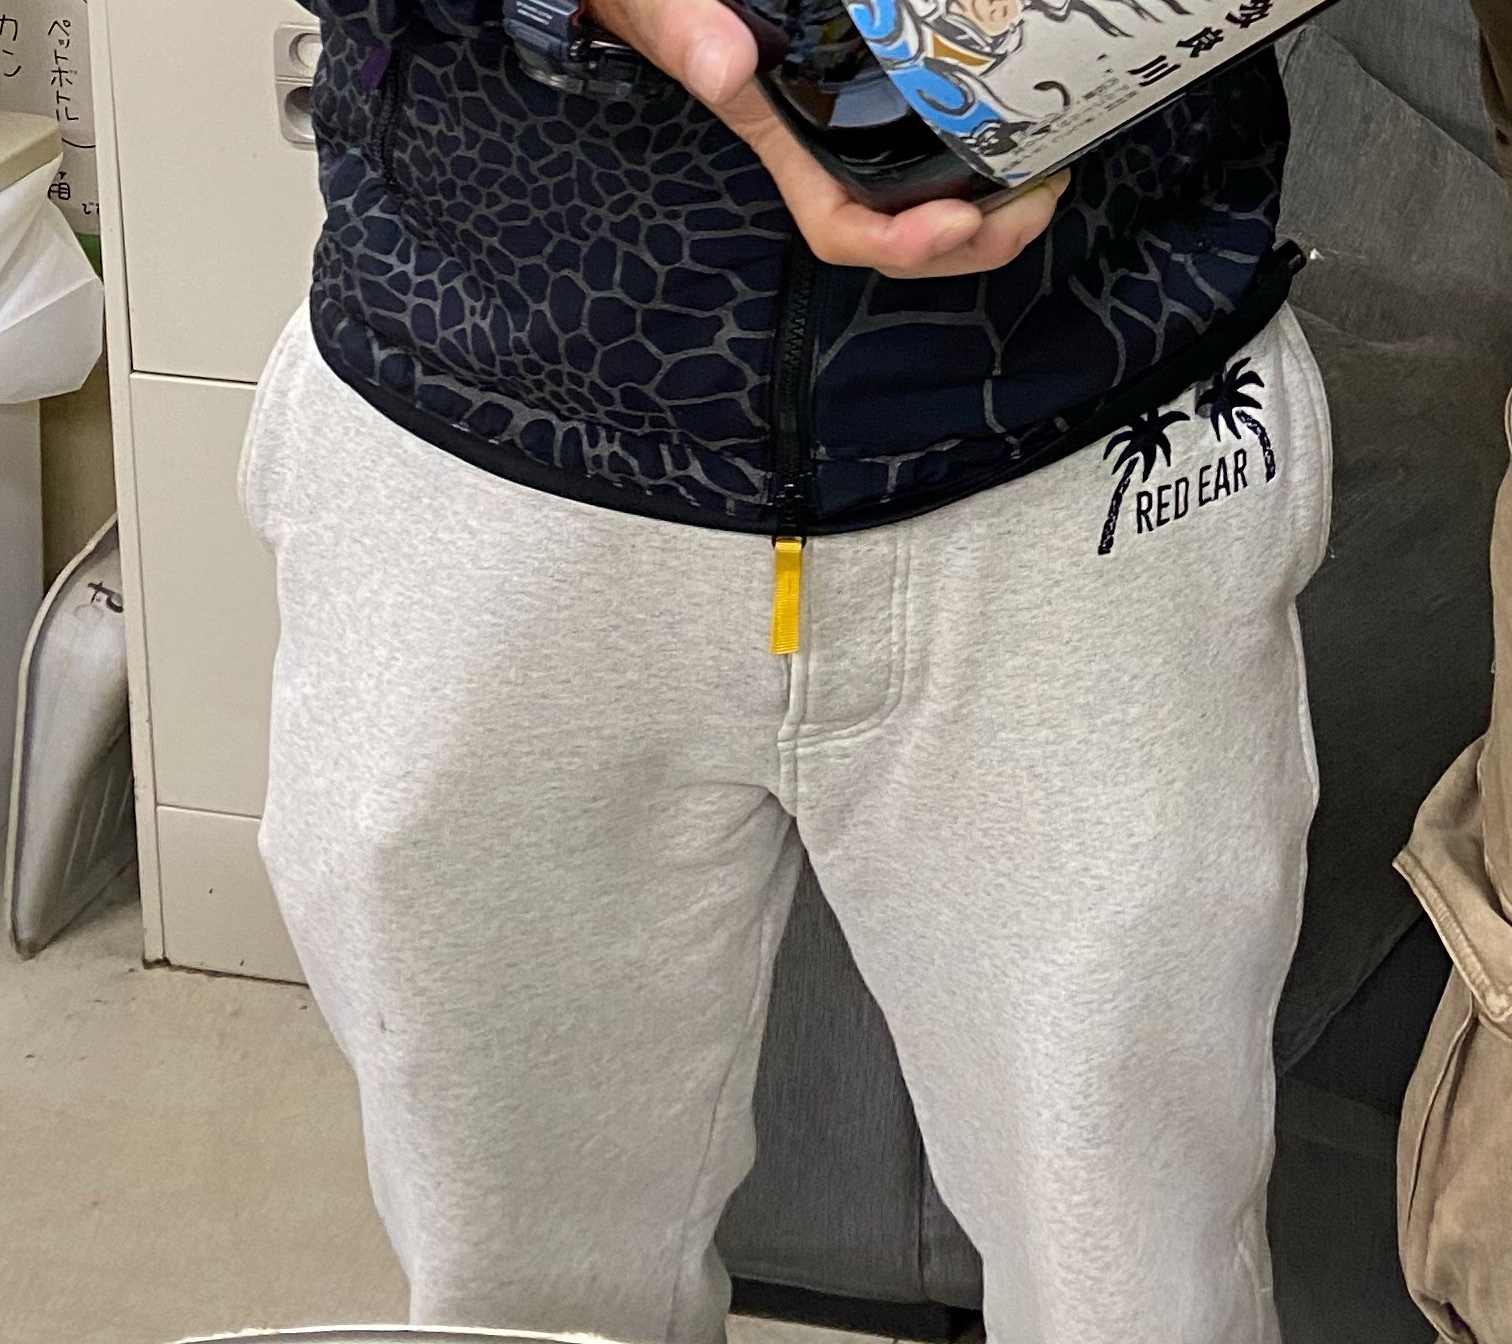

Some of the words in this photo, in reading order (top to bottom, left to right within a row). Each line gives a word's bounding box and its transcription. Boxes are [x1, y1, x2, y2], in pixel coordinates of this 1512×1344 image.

[48, 19, 79, 122] ペットボトル
[1136, 477, 1190, 534] RED
[1198, 448, 1249, 507] EAR
